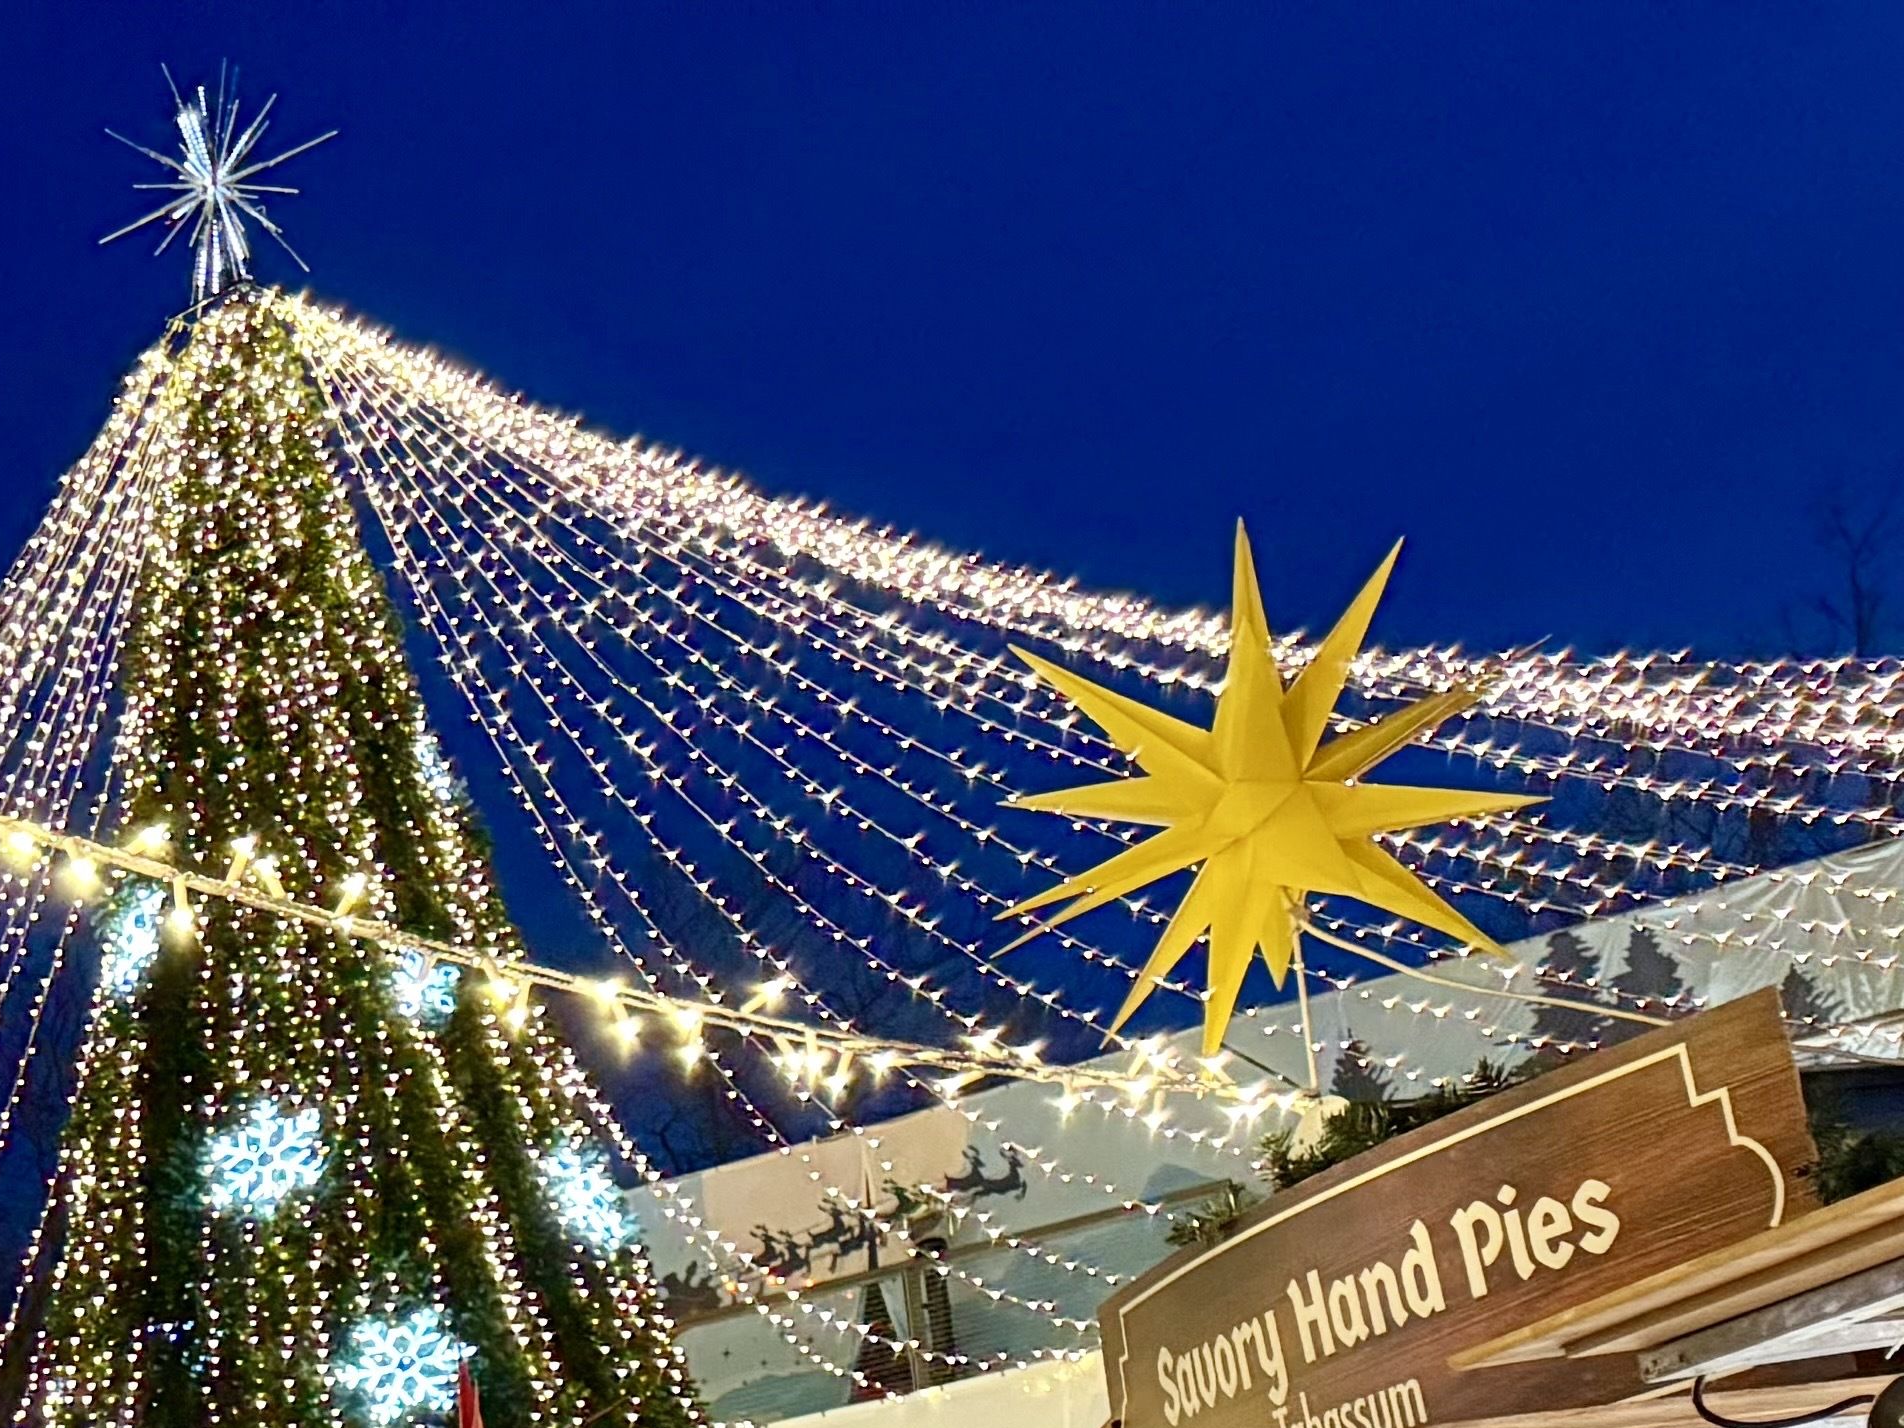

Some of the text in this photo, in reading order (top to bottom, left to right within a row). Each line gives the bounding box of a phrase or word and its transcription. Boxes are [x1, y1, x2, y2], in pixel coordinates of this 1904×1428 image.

[1157, 1178, 1621, 1427] Savory Hand Pies
